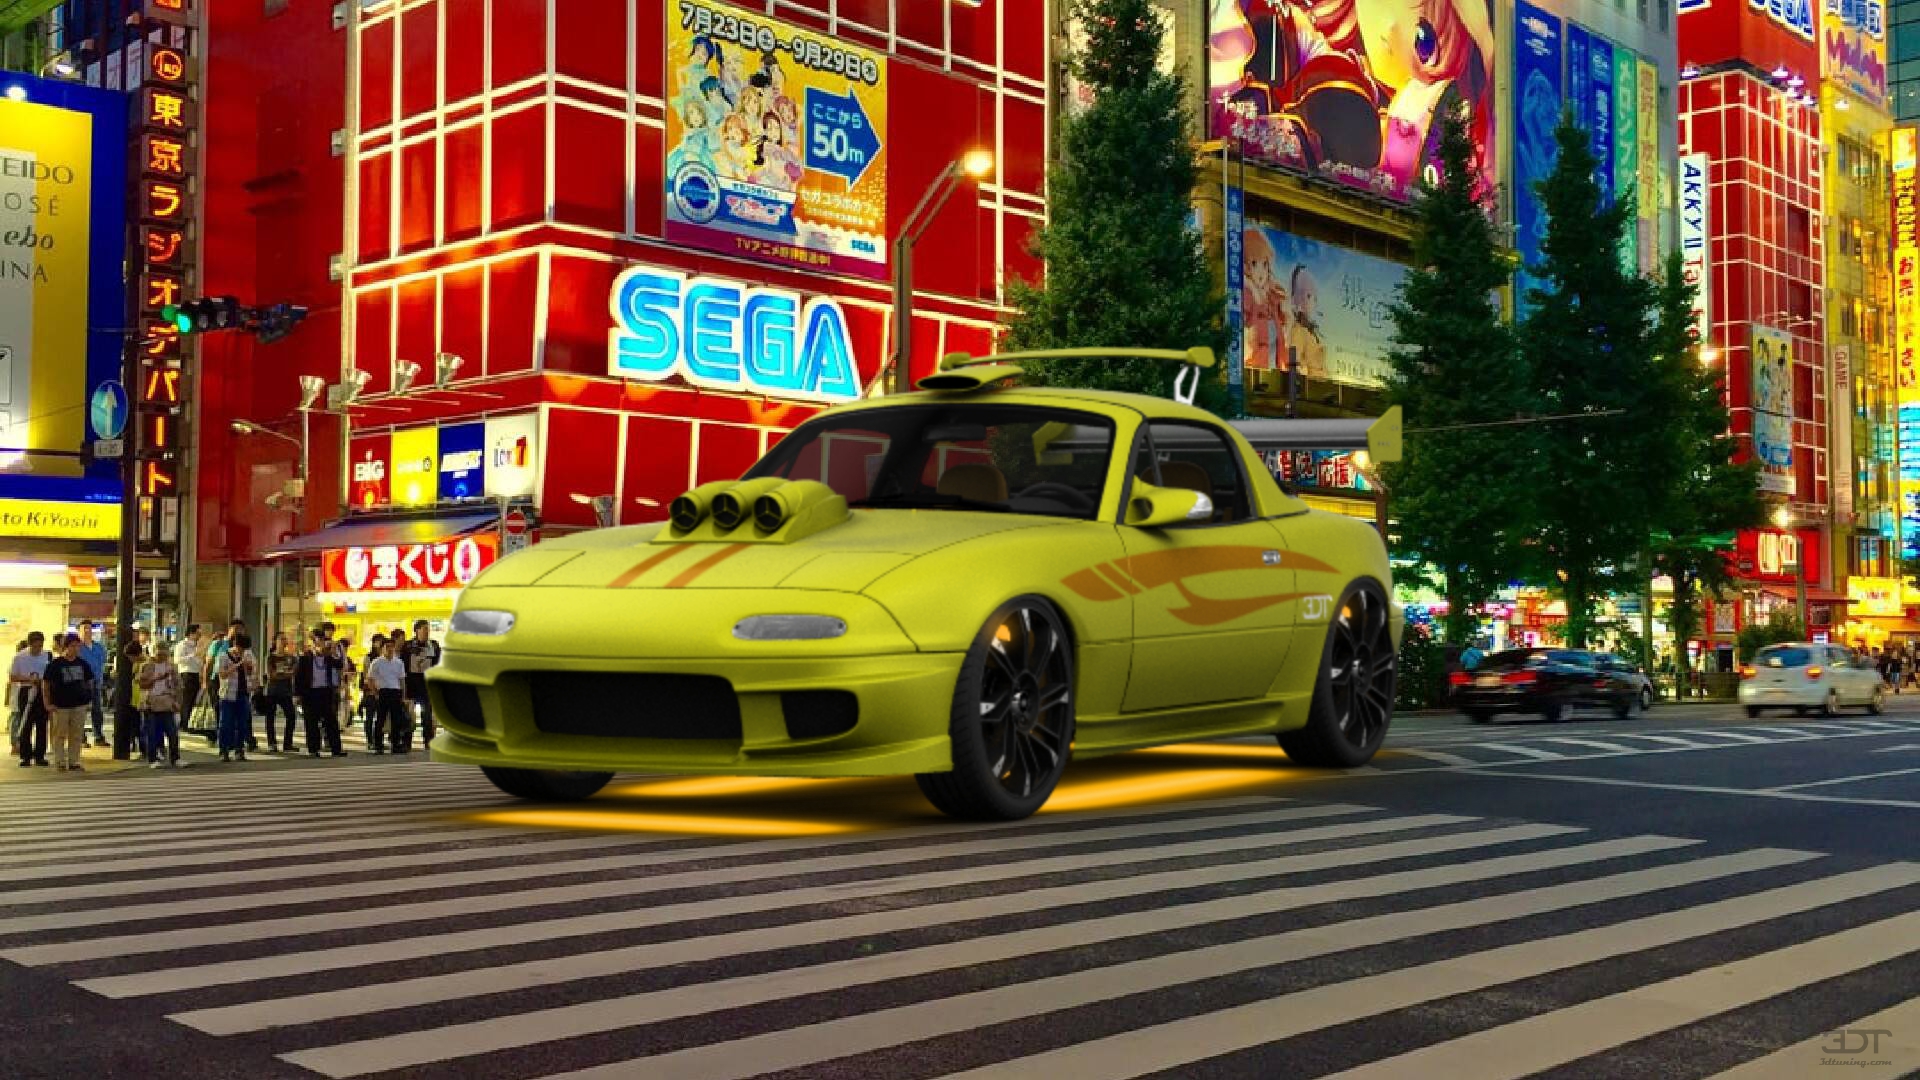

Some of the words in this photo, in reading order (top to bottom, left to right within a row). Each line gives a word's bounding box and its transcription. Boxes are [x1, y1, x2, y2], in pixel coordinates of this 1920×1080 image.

[811, 102, 863, 129] ここから
[1683, 162, 1702, 232] AKKY
[608, 264, 863, 400] SEGA
[371, 544, 450, 589] 宝くじ
